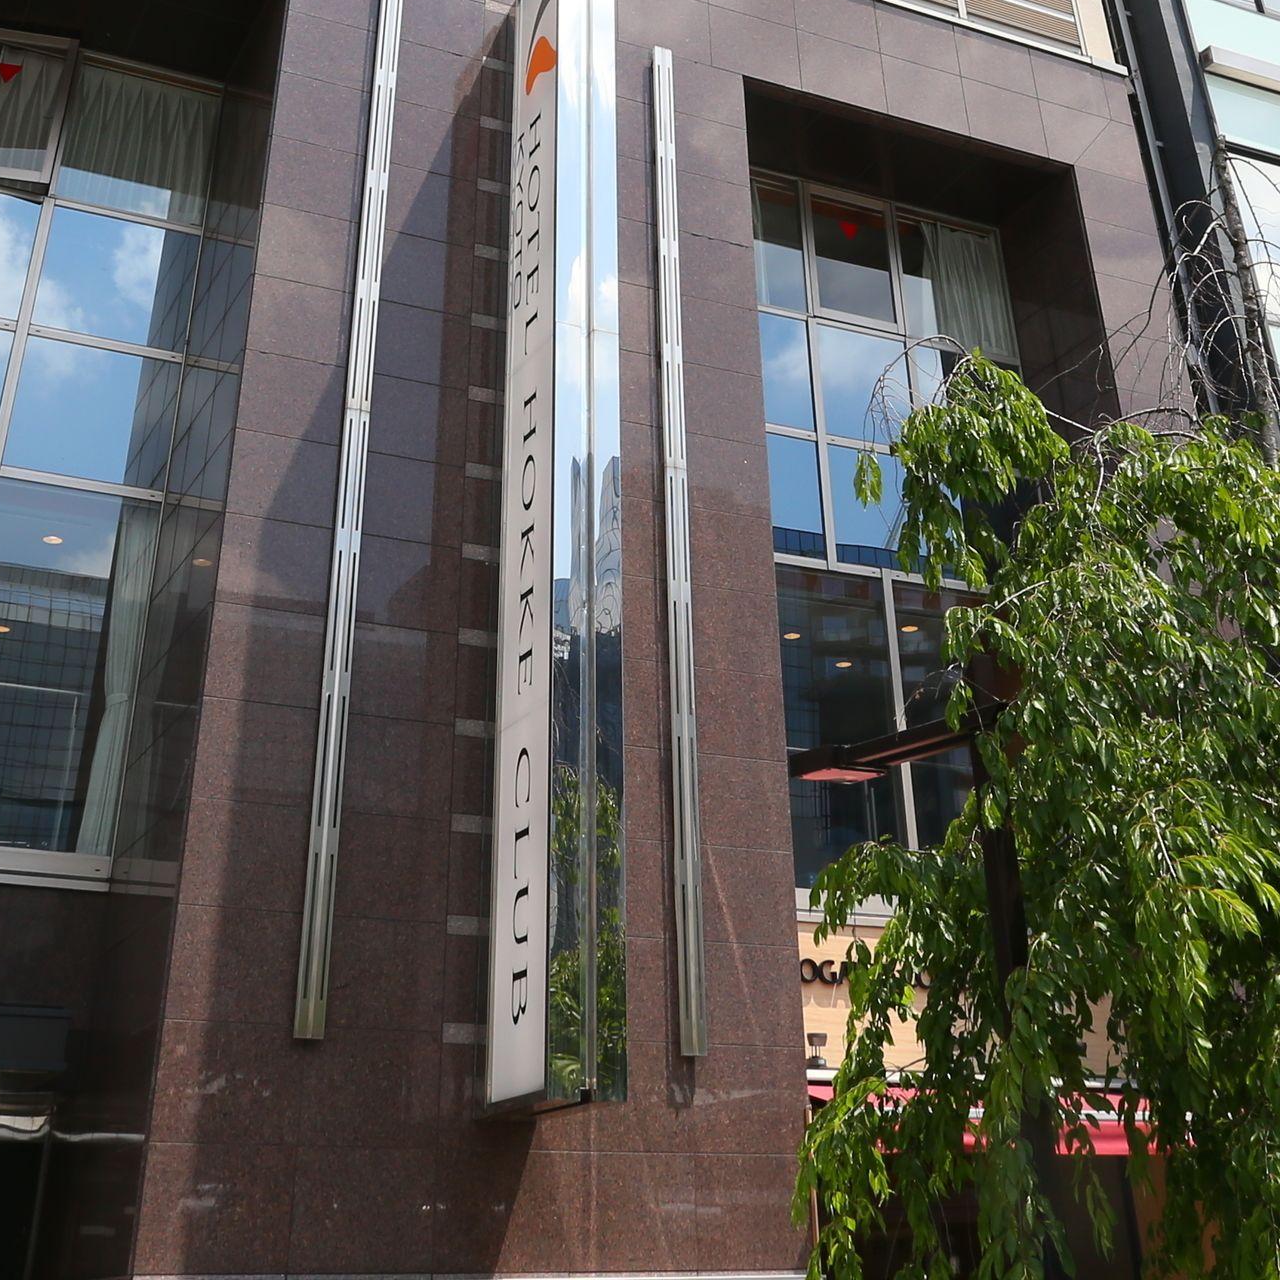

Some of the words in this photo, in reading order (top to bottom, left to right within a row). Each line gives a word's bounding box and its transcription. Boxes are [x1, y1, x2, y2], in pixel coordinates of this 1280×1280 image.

[513, 132, 526, 310] KYOTO
[524, 112, 542, 357] HOTEL
[517, 390, 538, 696] HOKKE
[510, 746, 532, 1026] CLUB
